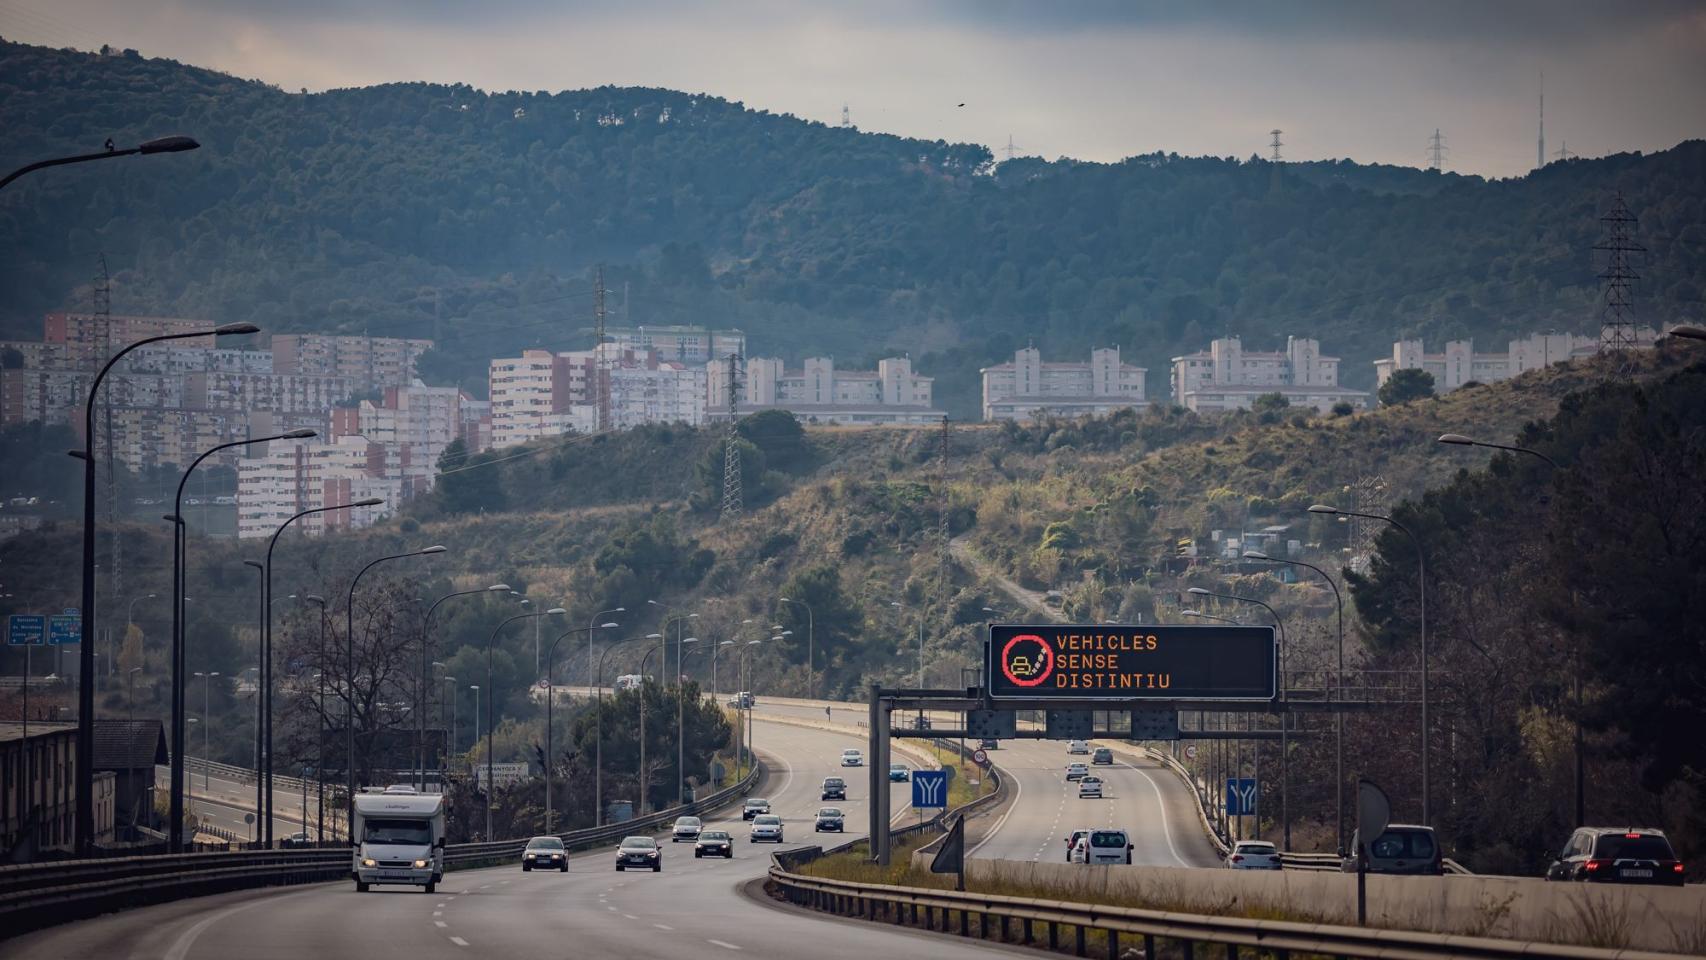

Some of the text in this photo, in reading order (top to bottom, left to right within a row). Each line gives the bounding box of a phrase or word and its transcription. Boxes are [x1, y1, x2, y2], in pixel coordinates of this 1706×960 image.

[1057, 635, 1157, 650] VEHICLES
[1056, 654, 1118, 669] SENSE
[1056, 673, 1170, 688] DISTINTIU
